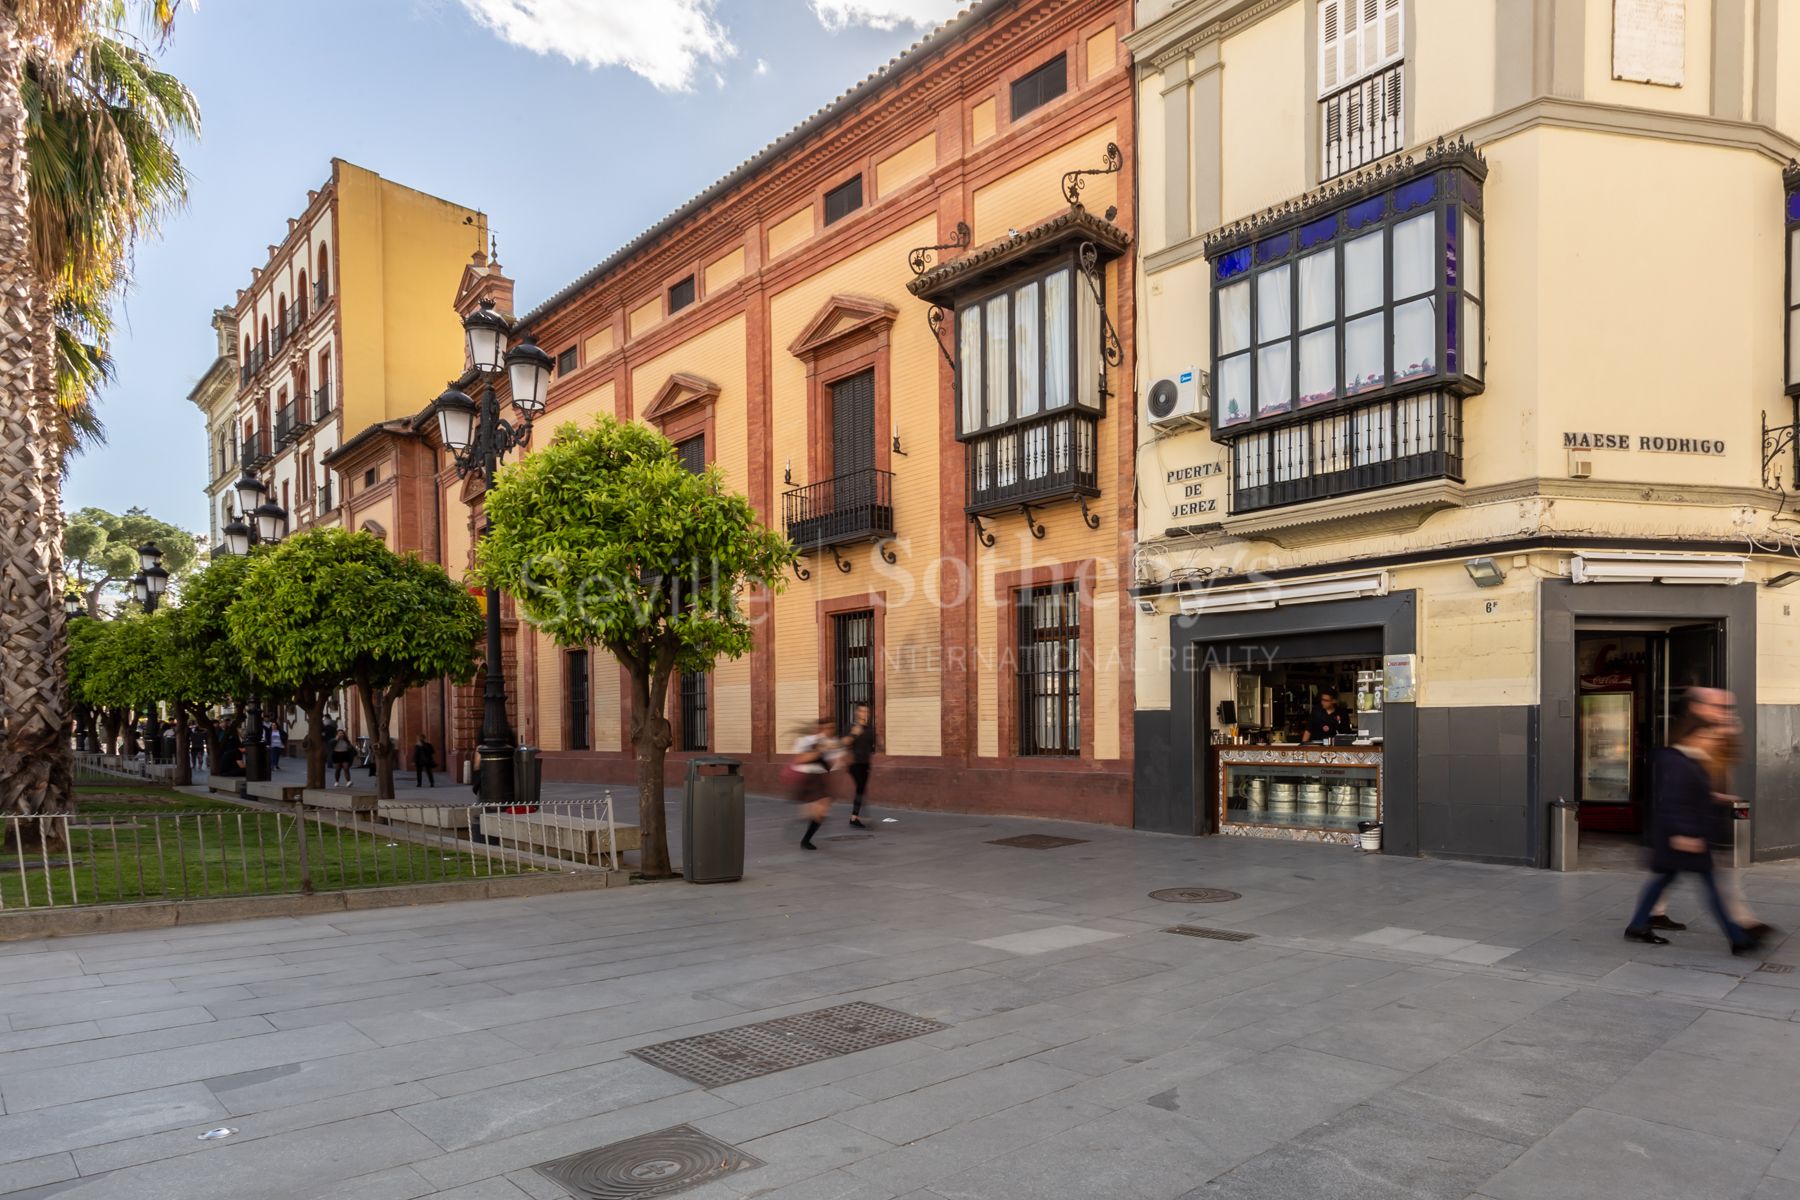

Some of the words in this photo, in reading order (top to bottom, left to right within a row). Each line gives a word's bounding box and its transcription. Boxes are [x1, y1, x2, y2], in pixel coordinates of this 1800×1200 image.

[1563, 432, 1630, 449] MAESE
[1640, 436, 1725, 454] RODRIGO
[1167, 462, 1222, 482] PUERTA
[1185, 483, 1202, 497] DE
[1172, 499, 1216, 516] JEREZ
